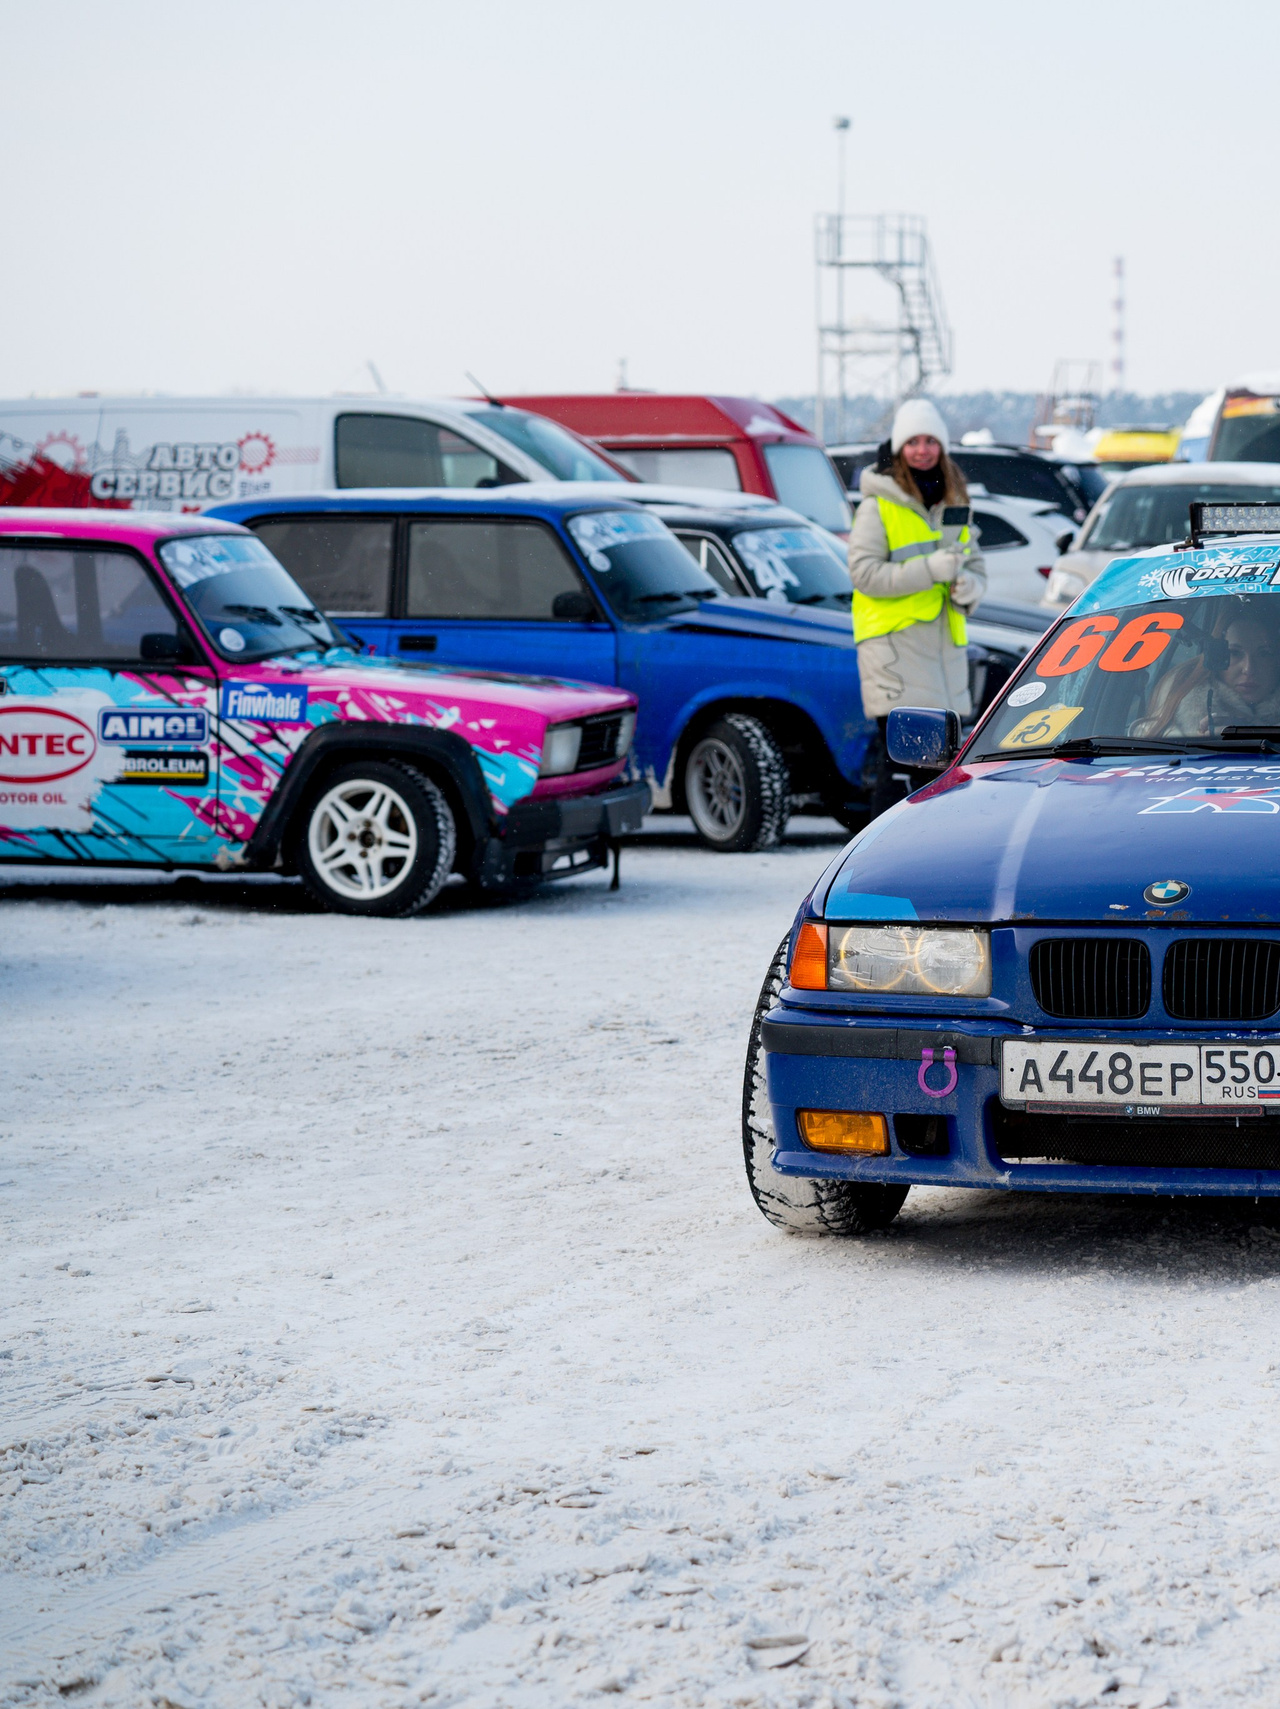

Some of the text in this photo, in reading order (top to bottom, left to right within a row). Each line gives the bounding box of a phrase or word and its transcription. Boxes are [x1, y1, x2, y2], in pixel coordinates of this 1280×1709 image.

[150, 442, 241, 470] АВТО
[91, 472, 233, 499] СЕРВИС
[1193, 563, 1274, 580] DRIFT
[1224, 575, 1257, 584] EXPO
[1035, 612, 1184, 678] 66
[227, 689, 301, 720] Finwhale
[103, 716, 203, 738] AIMOL
[0, 733, 85, 755] NTEC
[0, 792, 67, 804] OTOR OIL
[1205, 1051, 1275, 1084] 550
[1222, 1086, 1256, 1099] RUS
[1136, 1106, 1160, 1115] BMW
